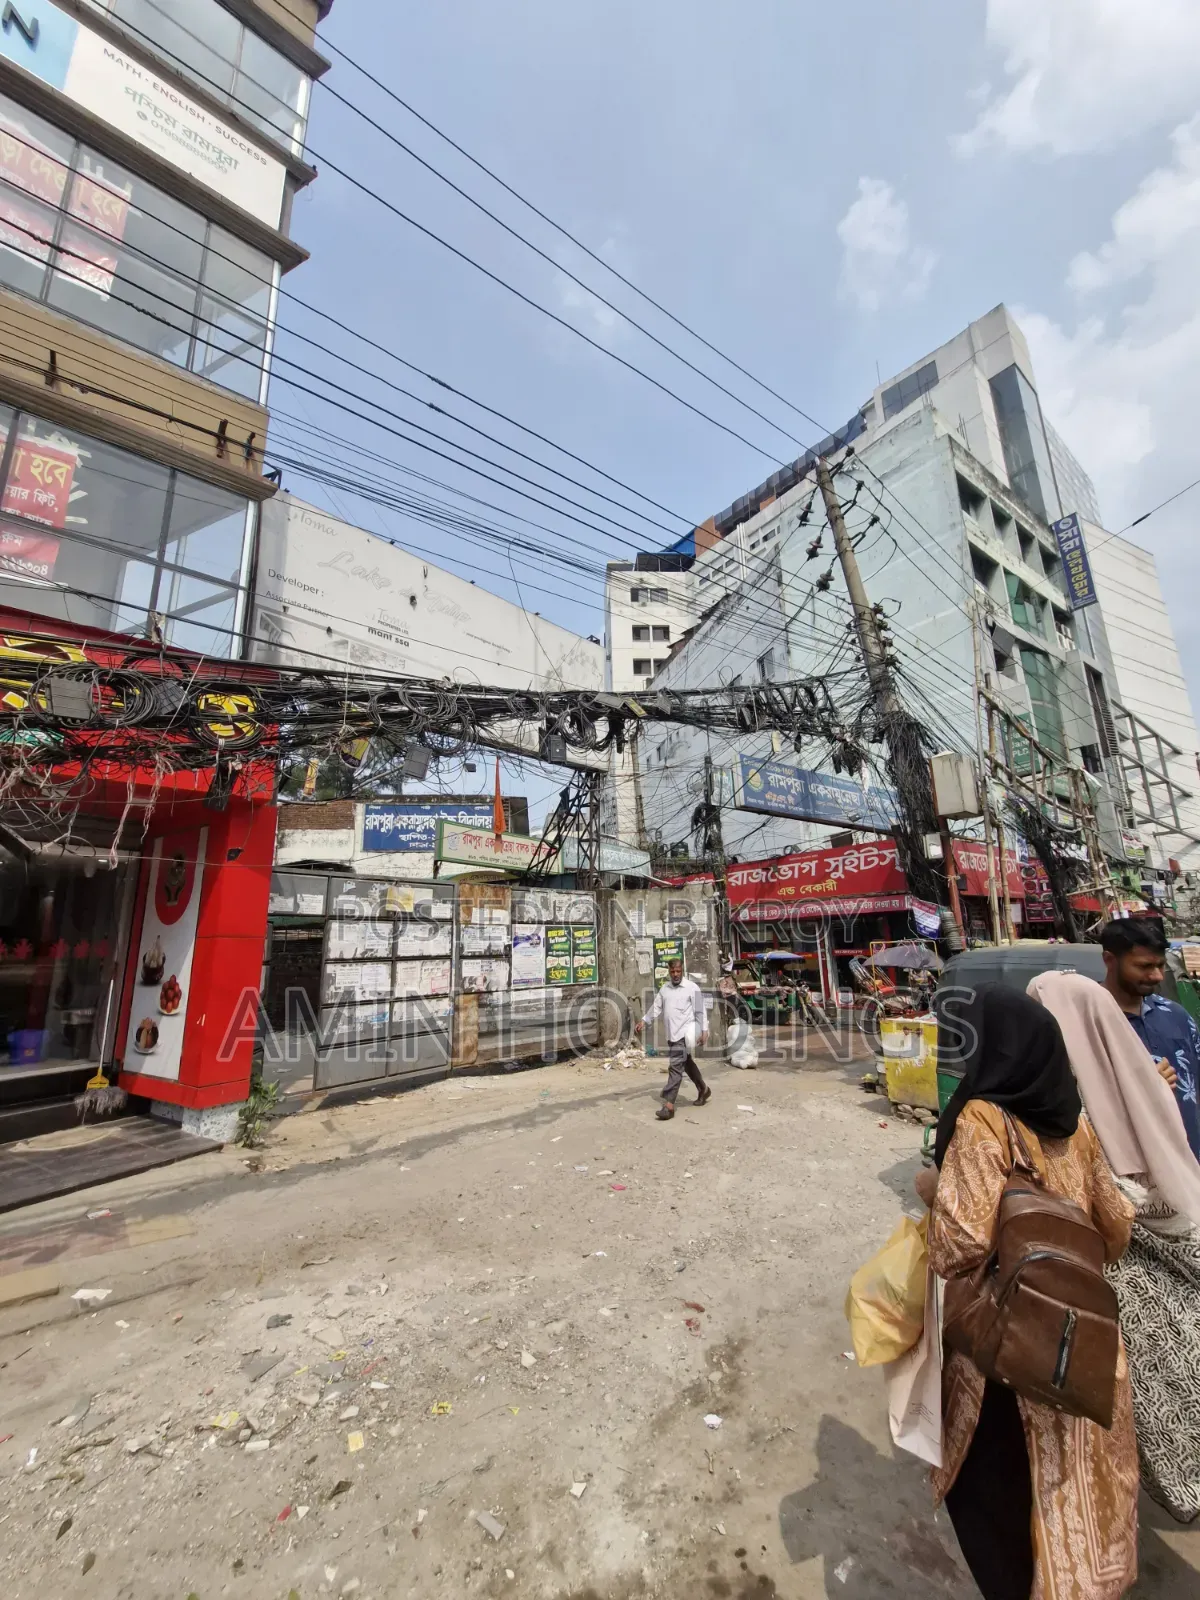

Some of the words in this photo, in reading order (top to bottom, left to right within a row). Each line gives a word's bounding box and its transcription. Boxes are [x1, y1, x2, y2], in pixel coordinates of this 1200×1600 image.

[103, 48, 142, 79] MATH
[152, 81, 206, 124] ENGLISH
[215, 125, 268, 166] SUCCESS
[124, 85, 180, 129] পশ্চিম
[30, 451, 71, 489] হবে
[267, 568, 319, 595] Developer
[265, 590, 302, 608] Associate
[766, 771, 805, 795] রামপুরা
[365, 812, 394, 833] রামপুরা
[462, 833, 483, 850] রামপুরা
[727, 860, 819, 886] রাজভোগ
[777, 885, 796, 896] এন্ড
[800, 879, 838, 895] বেকারী
